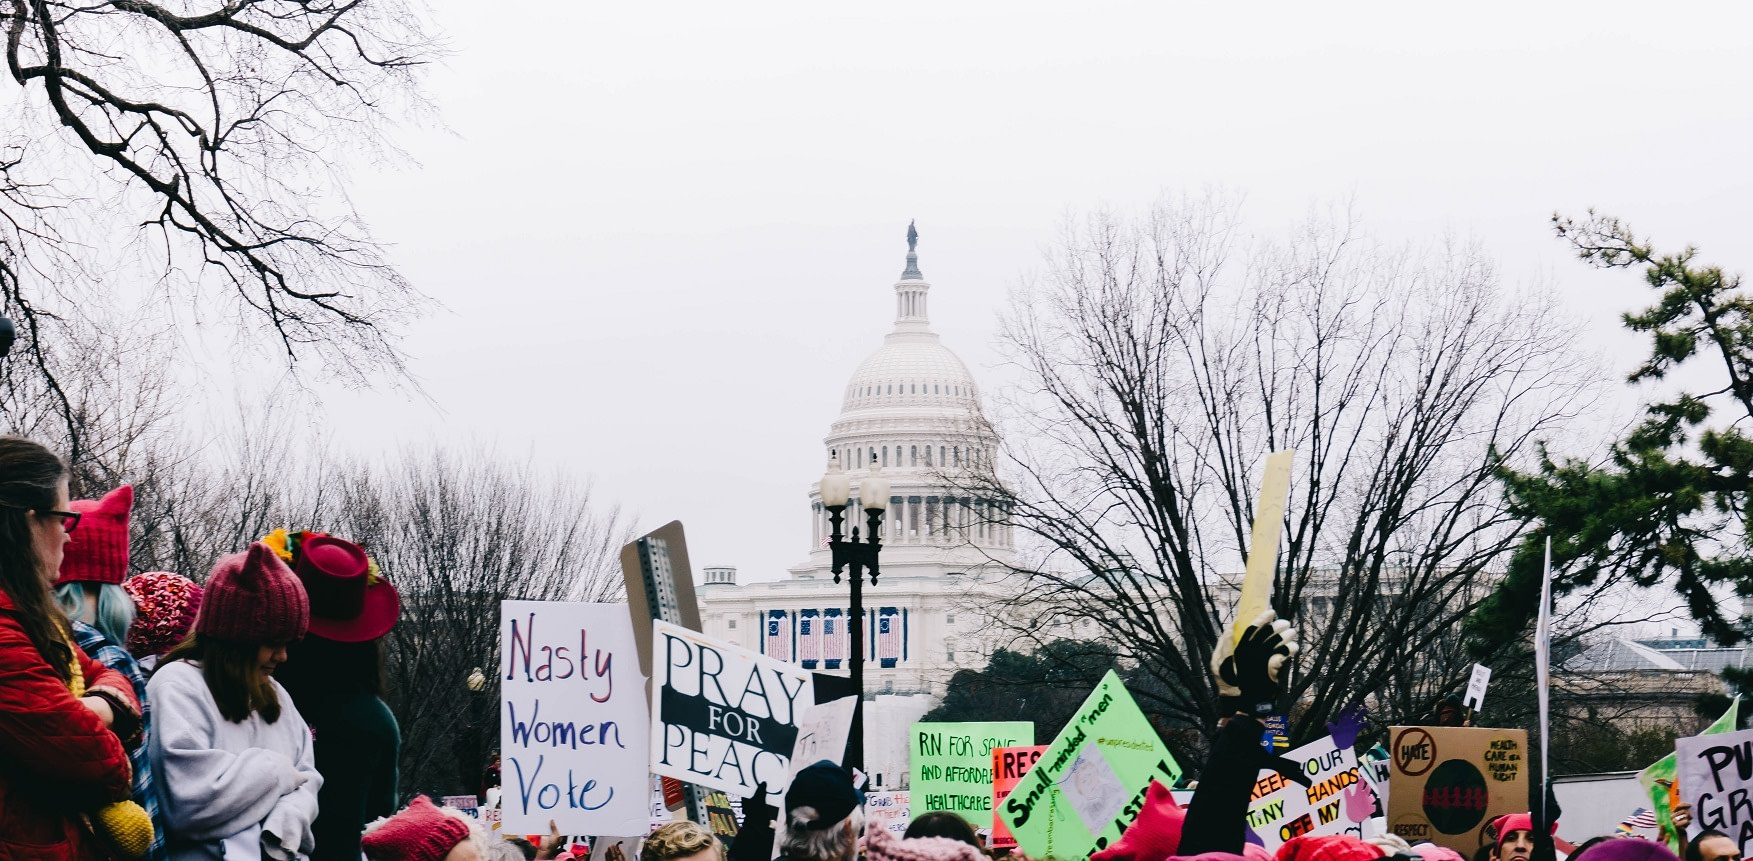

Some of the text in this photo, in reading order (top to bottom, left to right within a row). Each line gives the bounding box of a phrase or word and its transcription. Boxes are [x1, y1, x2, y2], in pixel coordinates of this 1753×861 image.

[506, 612, 612, 703] Nasty
[661, 632, 807, 728] PRAY
[507, 699, 625, 749] Women
[708, 705, 764, 745] FOR
[919, 731, 942, 757] RN
[949, 735, 974, 758] FOR
[1401, 744, 1430, 760] HATE
[1484, 751, 1507, 762] CARE
[506, 754, 614, 816] Vote
[921, 765, 942, 781] AND
[1305, 766, 1359, 806] HANDS
[925, 794, 992, 811] HEALTHCARE
[1318, 799, 1341, 826] MY
[1280, 813, 1315, 842] OFF
[1394, 823, 1429, 836] RESPECT
